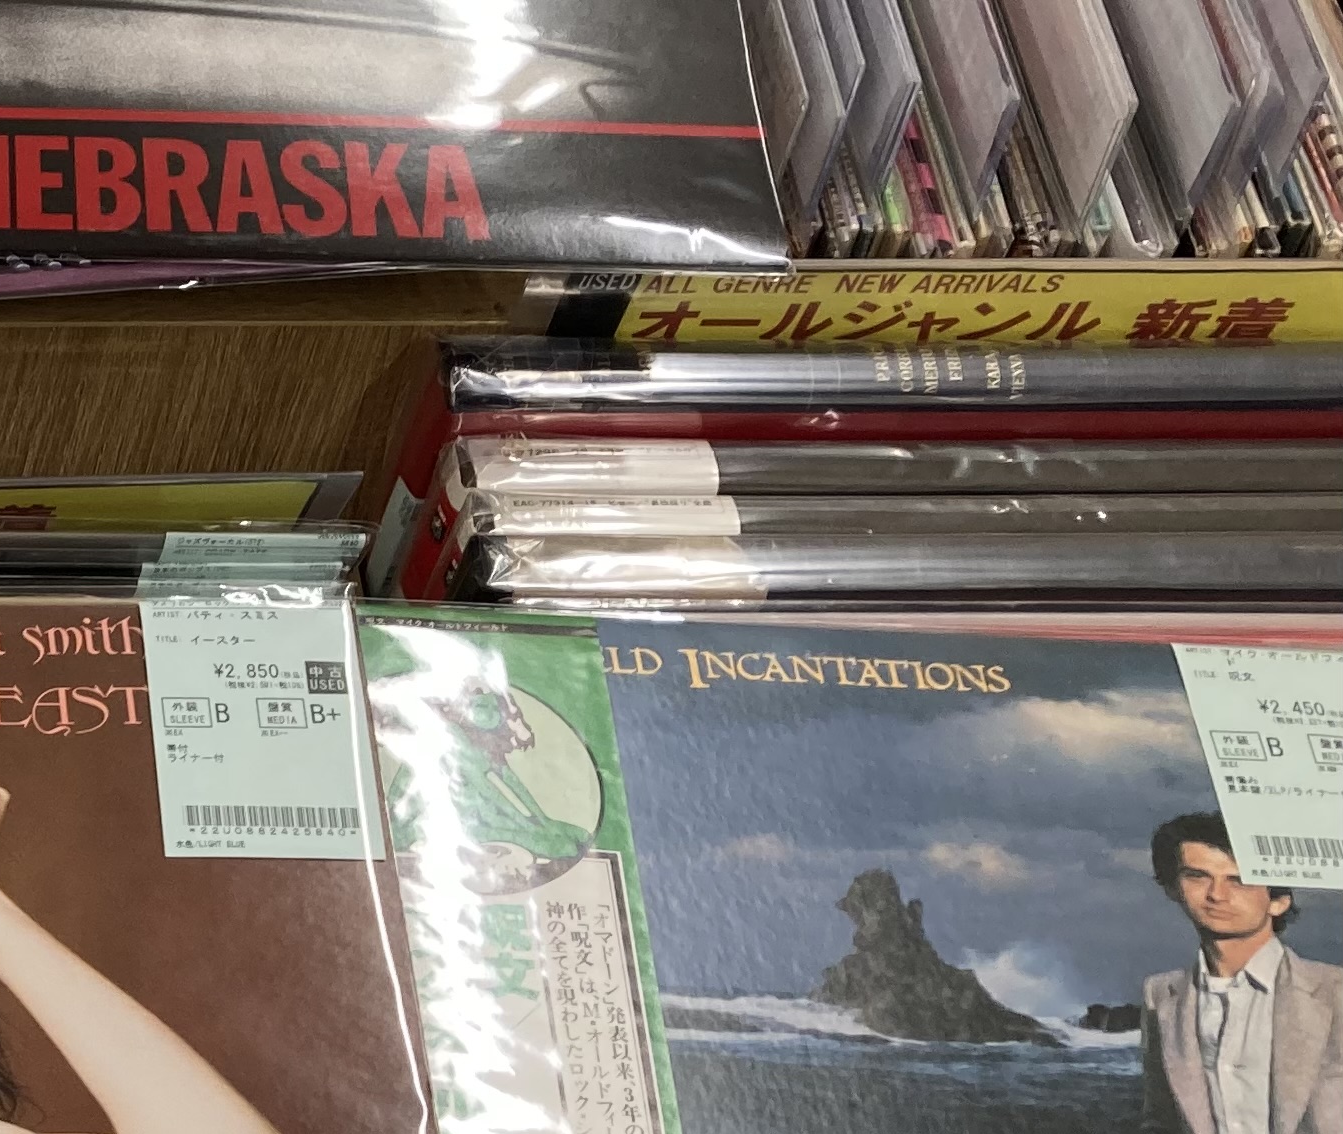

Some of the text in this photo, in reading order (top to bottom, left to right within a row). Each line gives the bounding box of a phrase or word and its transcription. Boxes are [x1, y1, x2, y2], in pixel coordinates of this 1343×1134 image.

[579, 274, 1065, 295] USED ALL GENRE NEW ARRIVALS
[633, 298, 1296, 343] オールジャンル 新着
[187, 610, 279, 620] パティ・スミス
[21, 615, 145, 666] smith
[190, 635, 256, 645] イースター
[309, 665, 343, 679] 中古
[309, 679, 345, 691] USED
[172, 702, 198, 713] 外装
[267, 702, 293, 713] 盤質
[215, 703, 231, 724] B
[310, 703, 342, 724] B+
[169, 715, 206, 725] SLEEVE
[267, 715, 298, 726] MEDIA
[1267, 737, 1284, 757] B
[166, 753, 225, 763] ライナー付
[226, 839, 246, 849] BLUE
